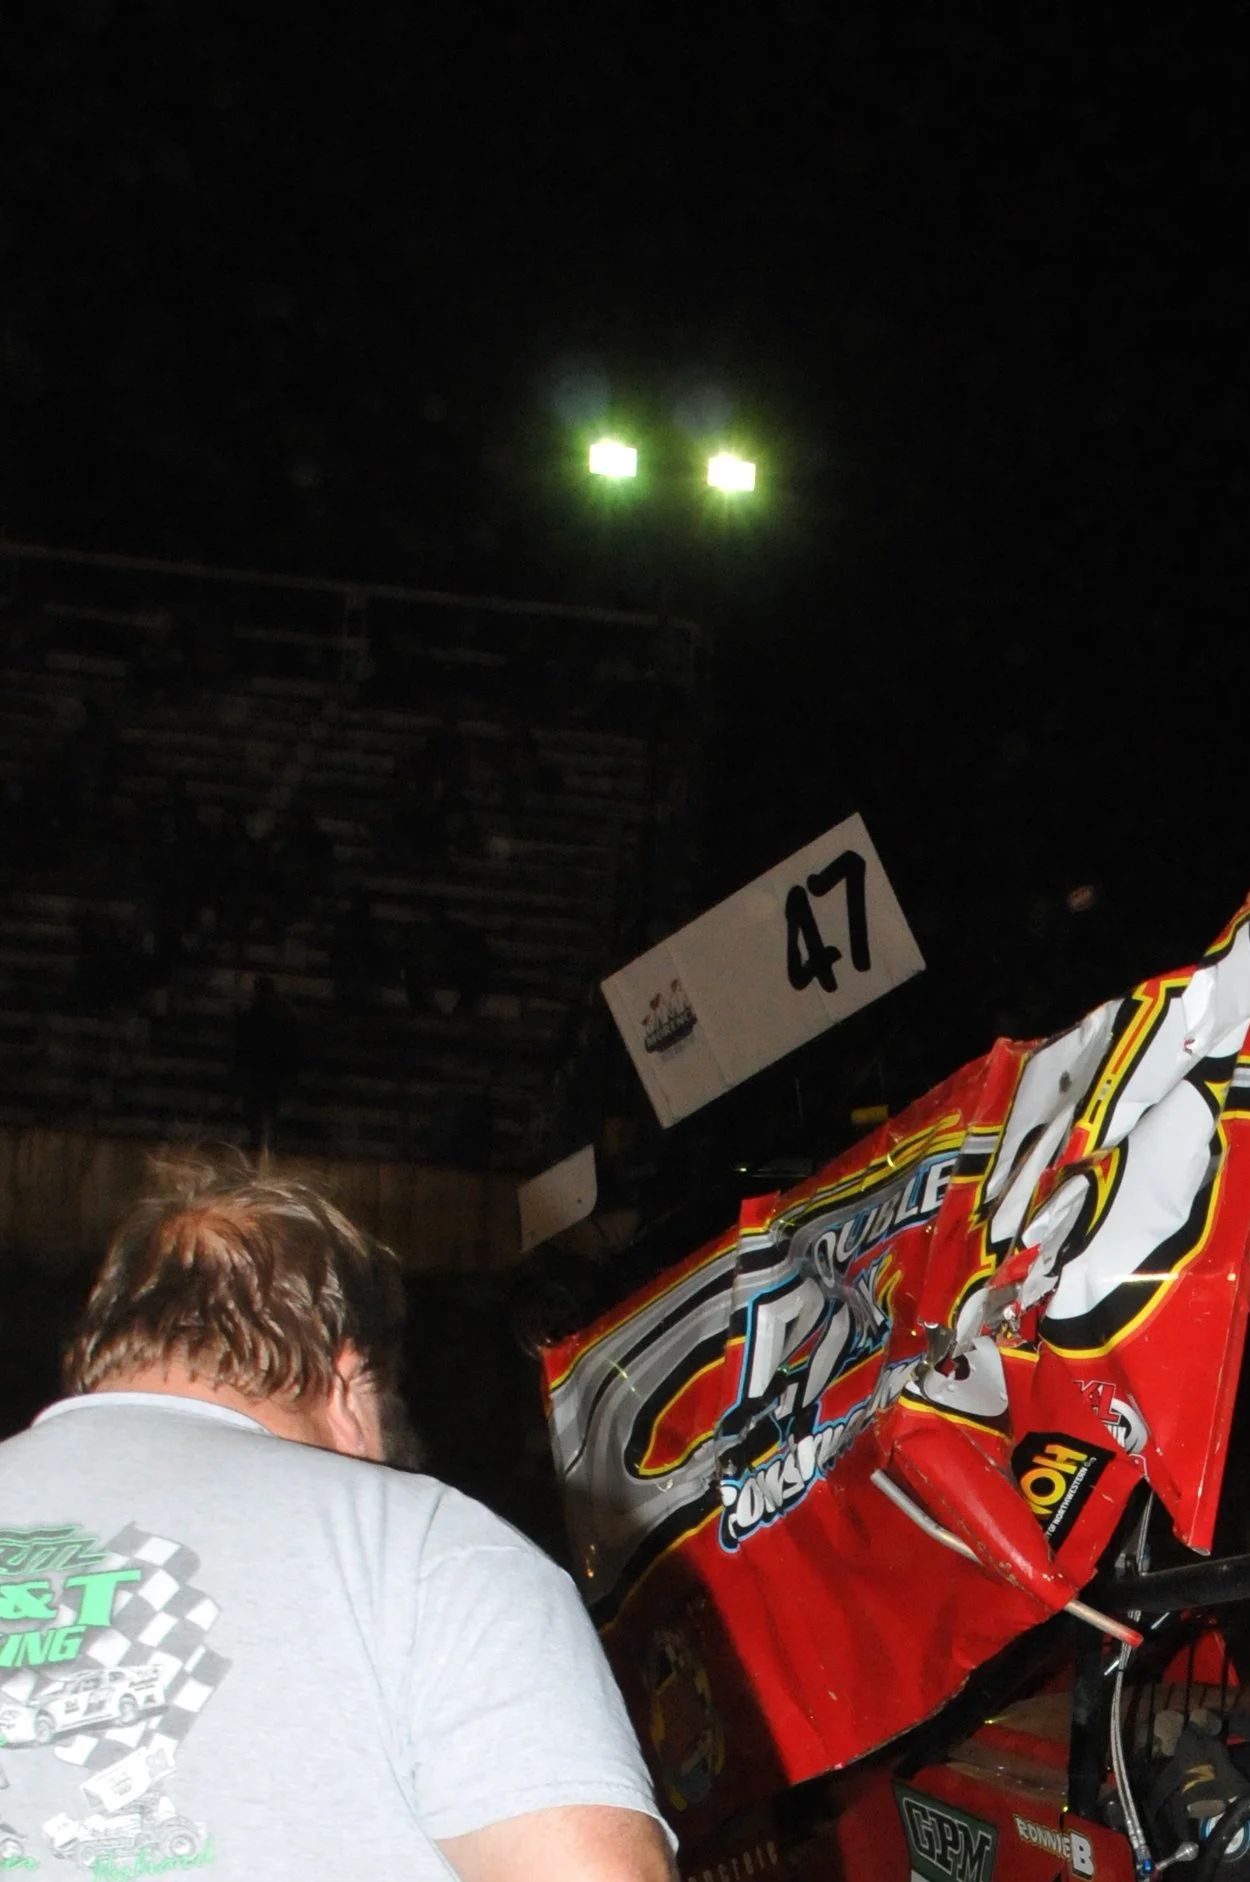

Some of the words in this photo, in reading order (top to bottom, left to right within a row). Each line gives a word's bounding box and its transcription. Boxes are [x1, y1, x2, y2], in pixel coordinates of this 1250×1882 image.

[785, 849, 871, 994] 47
[0, 1625, 86, 1668] ING
[1012, 1813, 1071, 1862] RONNIE
